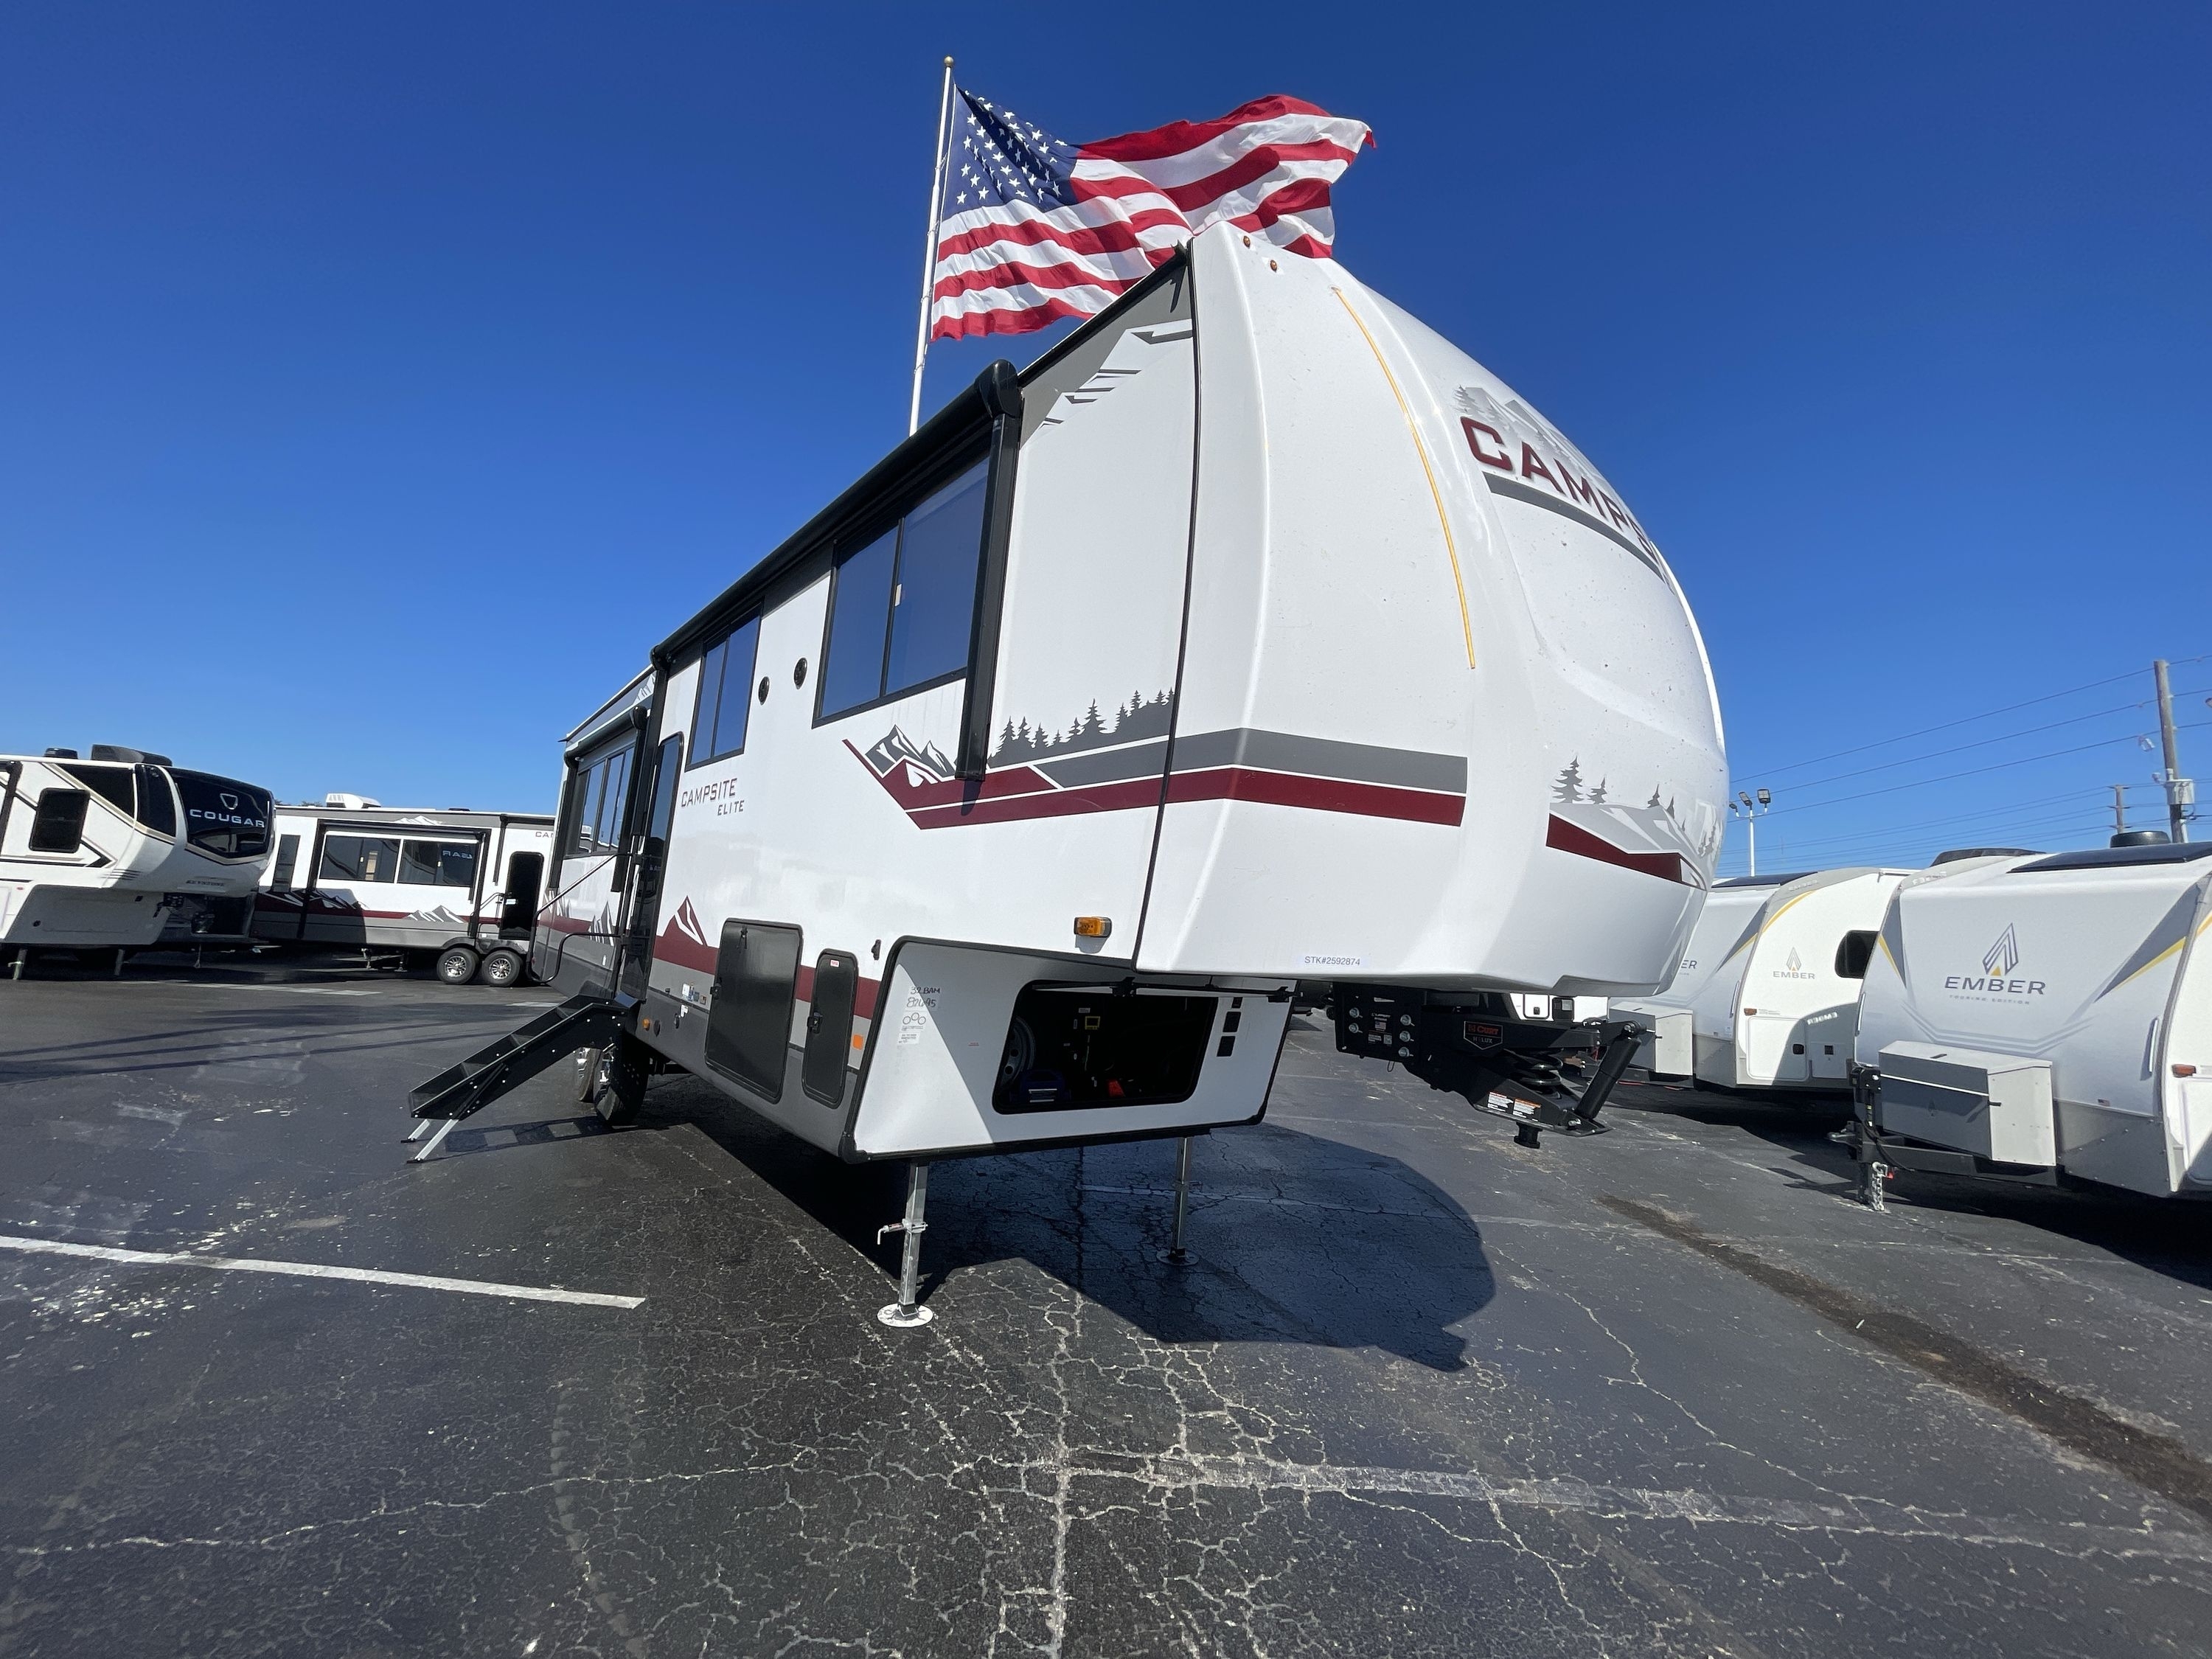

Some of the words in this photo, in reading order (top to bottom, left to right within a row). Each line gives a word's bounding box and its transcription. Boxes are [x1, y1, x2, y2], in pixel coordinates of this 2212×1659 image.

[681, 778, 737, 807] CAMPSITE
[717, 800, 745, 815] ELITE
[189, 809, 265, 828] COUGAR
[1304, 956, 1360, 966] STK#2592874
[1773, 970, 1816, 979] EMBER
[1944, 976, 2046, 995] EMBER
